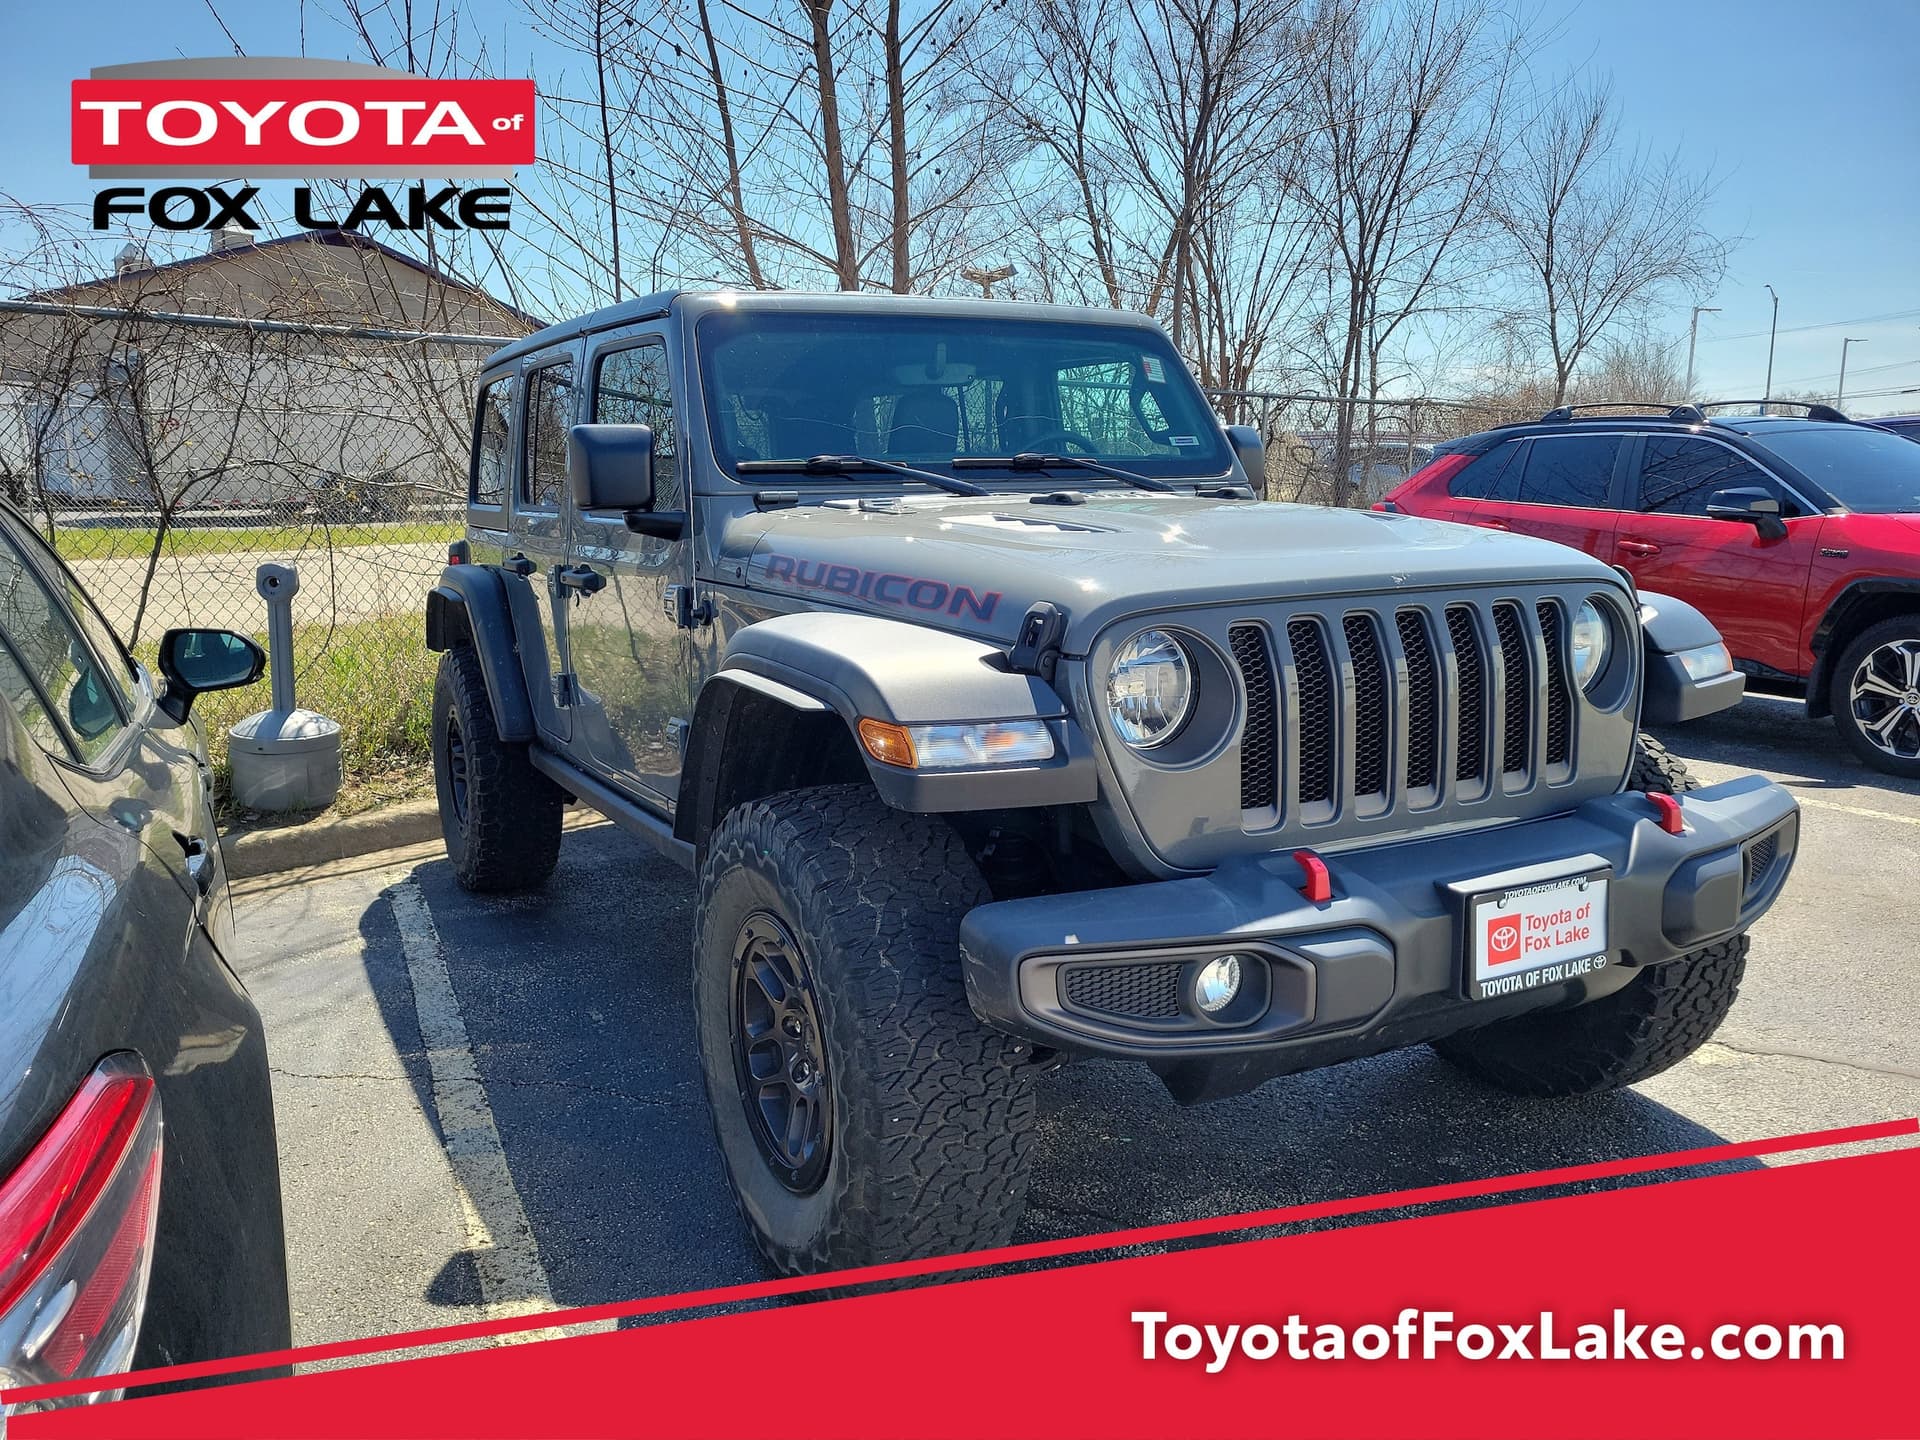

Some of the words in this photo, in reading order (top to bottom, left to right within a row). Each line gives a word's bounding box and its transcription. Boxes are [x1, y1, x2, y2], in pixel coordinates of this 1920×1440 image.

[765, 554, 1002, 622] RUBICON
[1525, 909, 1572, 932] Toyota
[1576, 902, 1591, 919] of
[1524, 932, 1551, 953] Fox
[1555, 926, 1590, 946] Lake
[1480, 977, 1523, 998] TOYOTA
[1525, 971, 1540, 987] OF
[1542, 965, 1563, 984] FOX
[1565, 957, 1591, 976] LAKE
